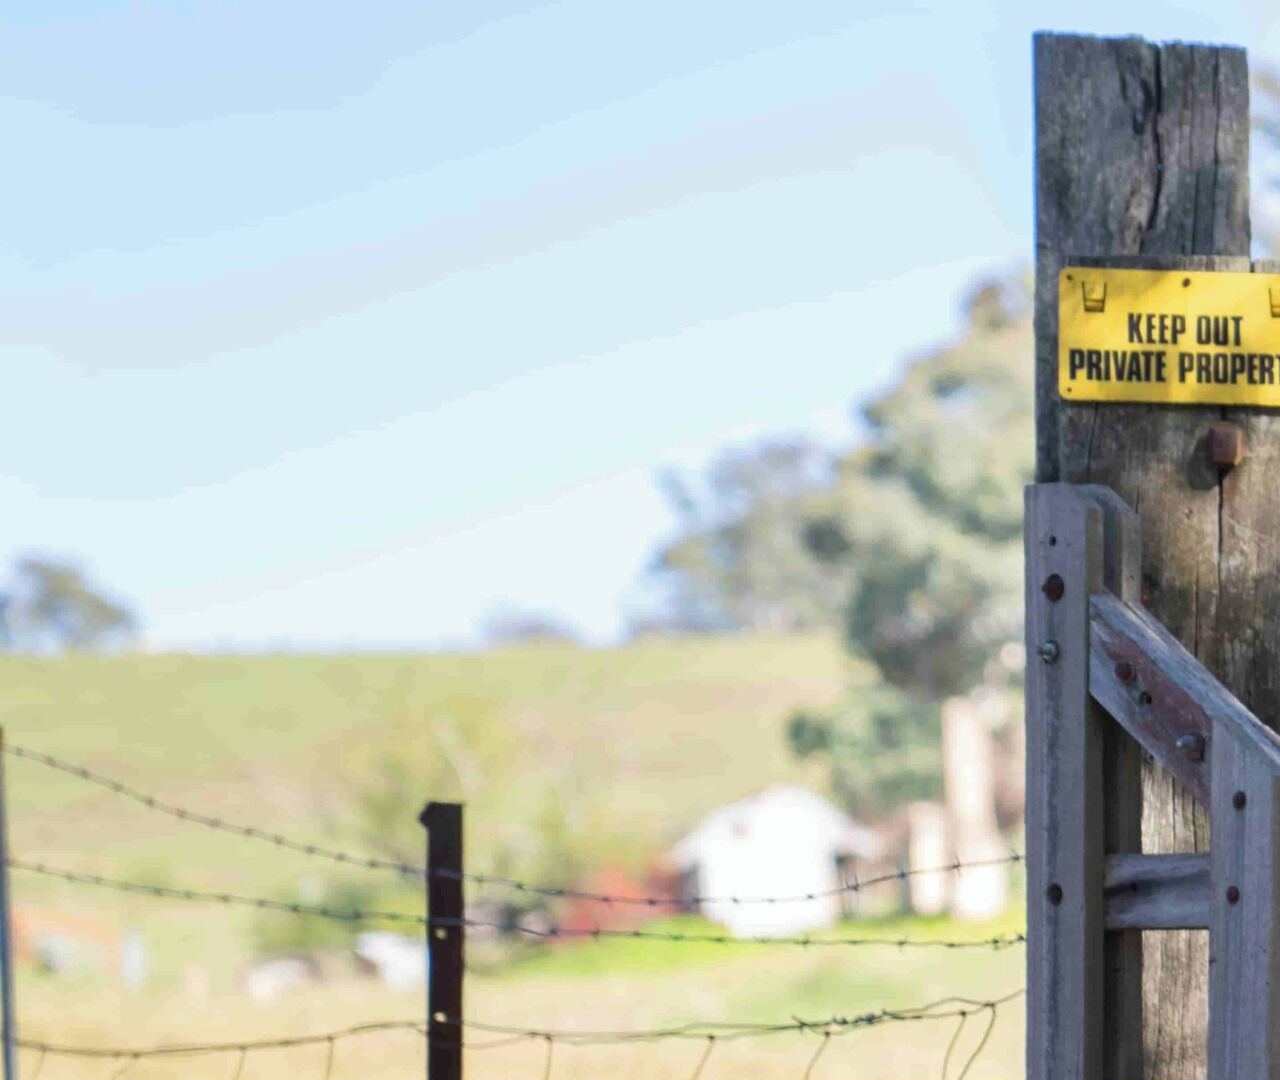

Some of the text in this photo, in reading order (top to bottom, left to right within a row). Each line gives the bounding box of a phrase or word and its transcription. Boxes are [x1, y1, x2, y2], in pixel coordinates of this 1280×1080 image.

[1128, 313, 1243, 346] KEEP OUT
[1069, 349, 1167, 382] PRIVATE
